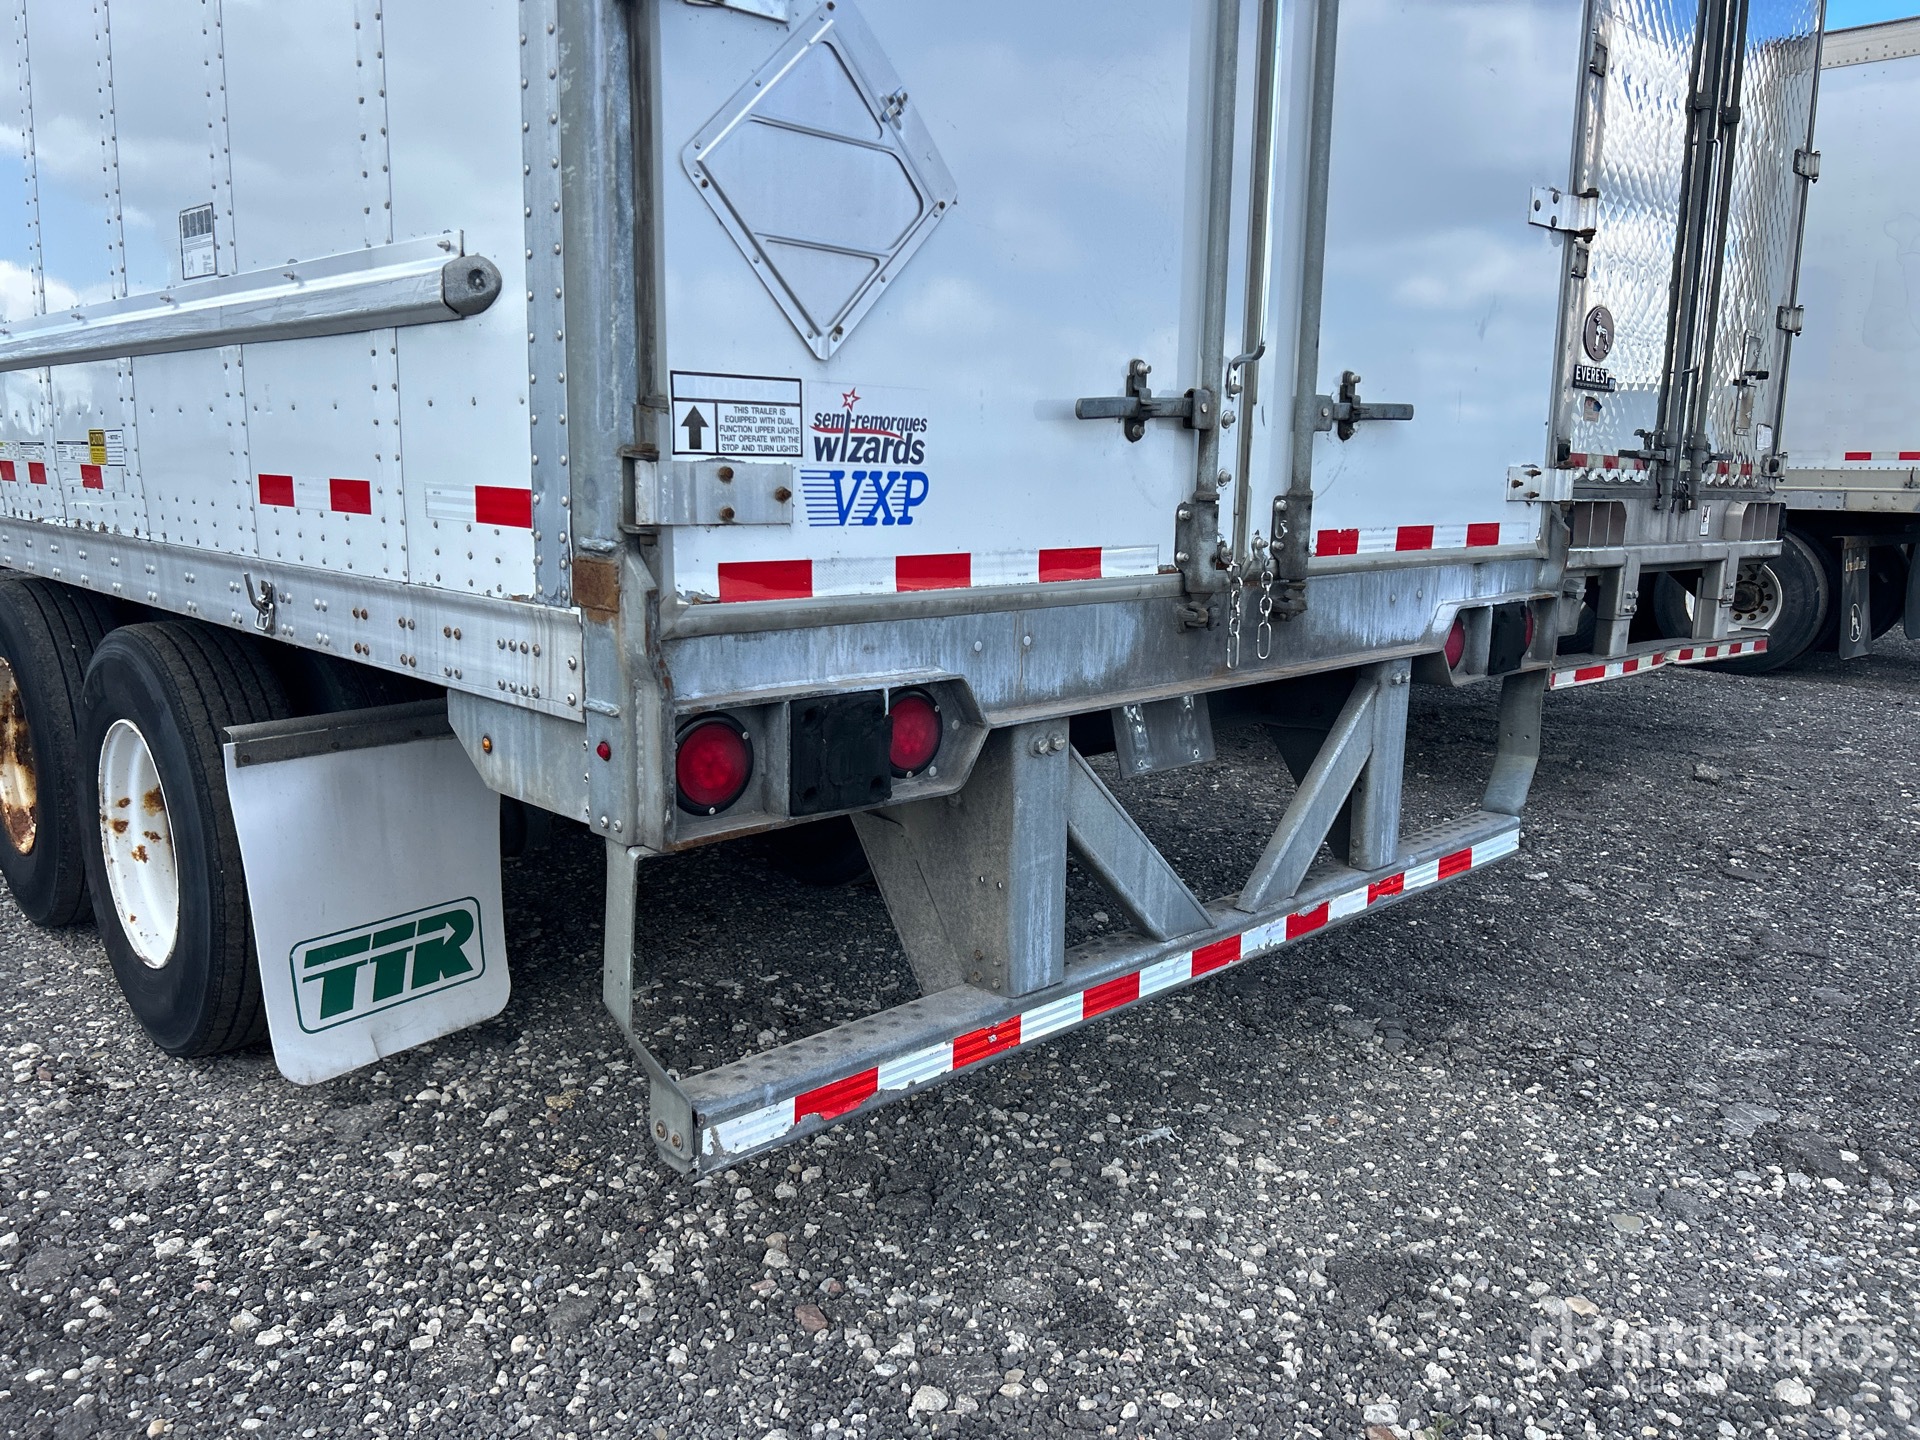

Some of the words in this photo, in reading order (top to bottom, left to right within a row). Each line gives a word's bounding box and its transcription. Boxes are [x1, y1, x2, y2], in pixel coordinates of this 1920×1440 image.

[1576, 365, 1609, 384] EVEREST
[733, 406, 749, 414] THIS
[751, 407, 777, 415] TRAILER
[780, 408, 786, 416] IS
[725, 415, 757, 424] EQUIPPED
[759, 417, 775, 425] WITH
[813, 409, 928, 438] semi-remorques
[719, 425, 752, 433] FUNCTION
[755, 426, 775, 434] UPPER
[778, 427, 799, 435] LIGHTS
[720, 434, 736, 442] THAT
[739, 435, 768, 443] OPERATE
[758, 445, 774, 453] TURN
[777, 445, 799, 453] LIGHTS
[813, 432, 926, 465] wizards
[829, 470, 929, 526] VXP
[302, 909, 474, 1020] TTR
